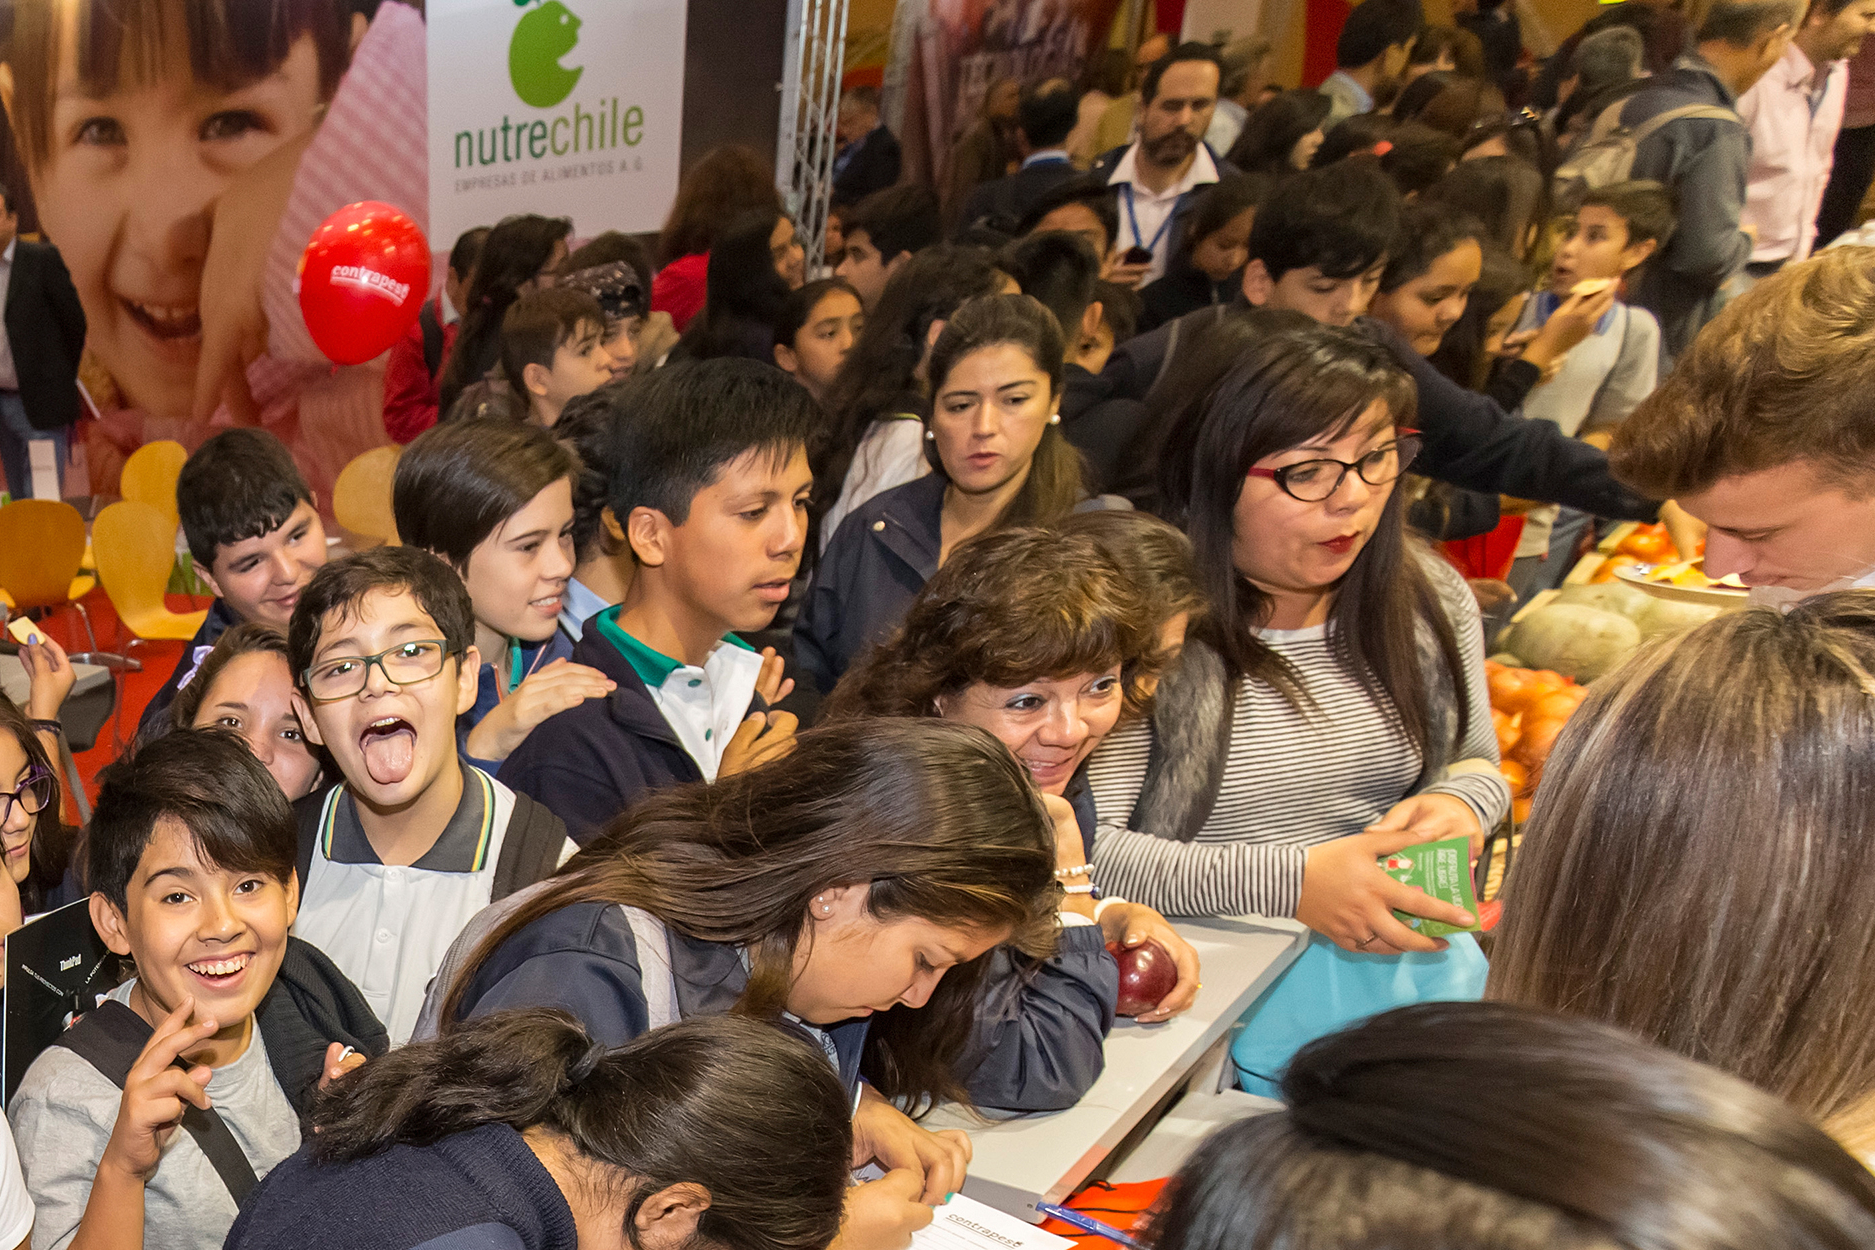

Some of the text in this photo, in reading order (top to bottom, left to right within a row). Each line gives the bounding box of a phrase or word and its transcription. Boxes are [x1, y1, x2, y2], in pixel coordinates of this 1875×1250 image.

[454, 97, 644, 168] nutrechile
[522, 169, 536, 184] DE
[83, 975, 92, 984] LA
